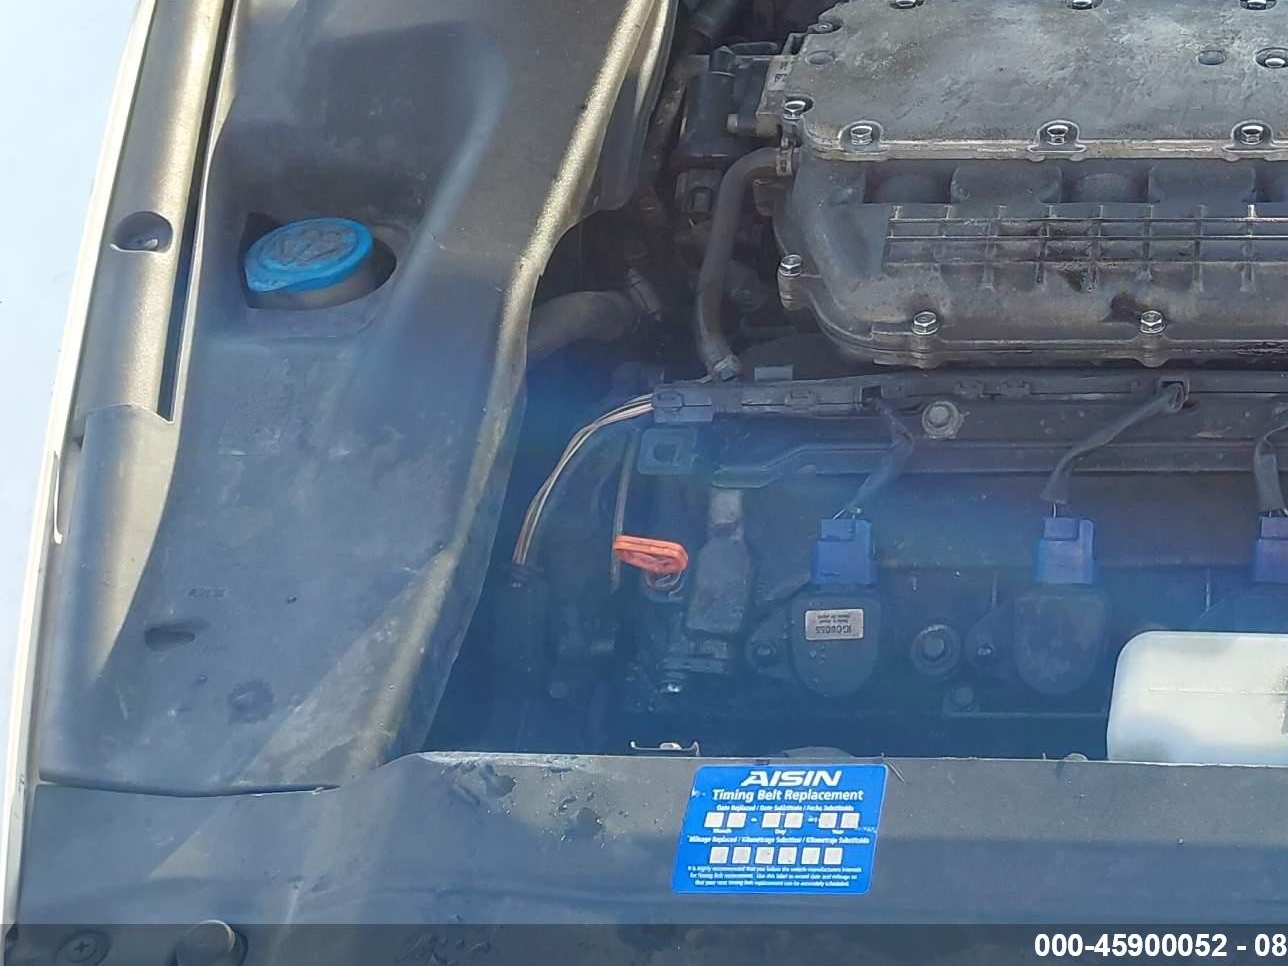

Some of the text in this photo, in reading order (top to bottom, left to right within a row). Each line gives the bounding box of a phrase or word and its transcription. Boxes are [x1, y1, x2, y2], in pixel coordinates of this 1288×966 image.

[740, 770, 843, 787] AISIN
[712, 789, 864, 804] Timing Belt Replacement
